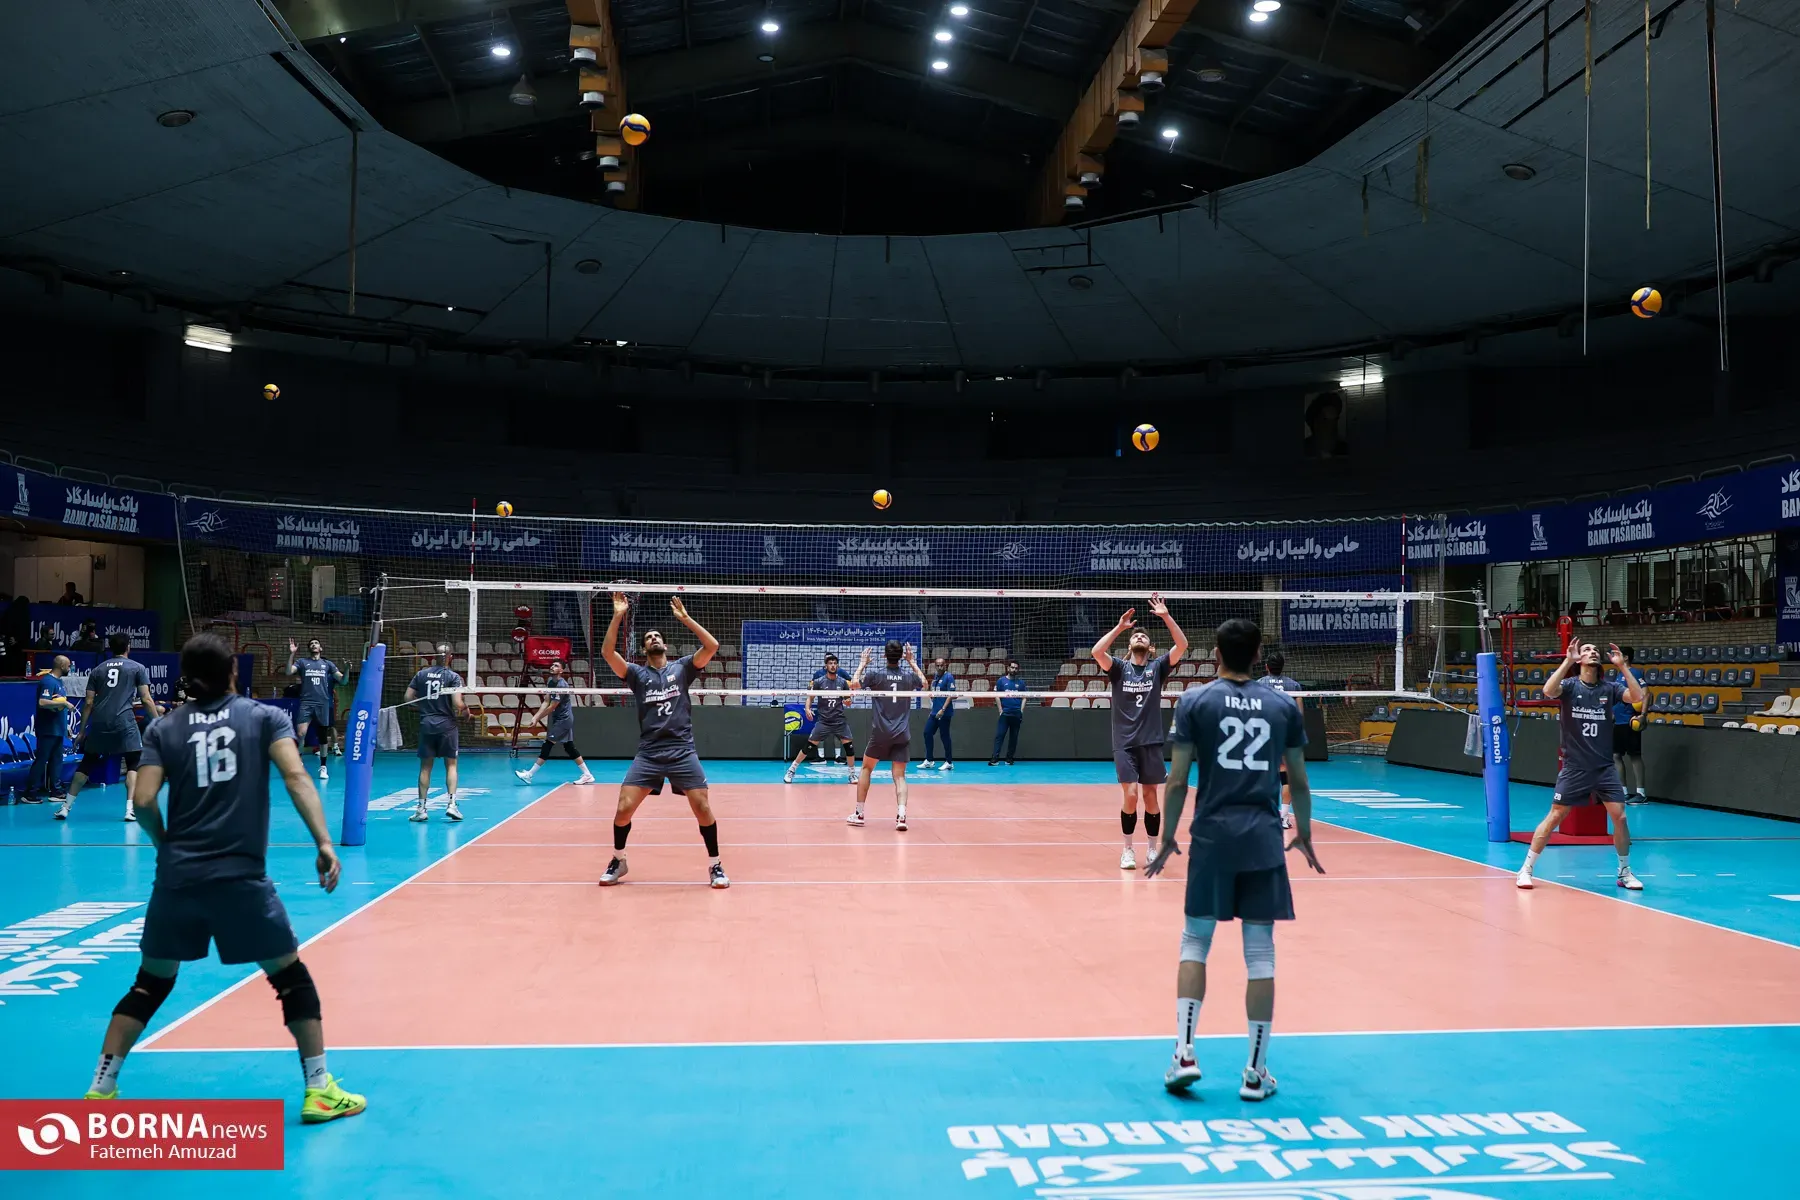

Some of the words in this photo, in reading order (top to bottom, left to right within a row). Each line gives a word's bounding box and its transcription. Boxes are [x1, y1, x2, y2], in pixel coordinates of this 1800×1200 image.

[111, 493, 140, 518] بانک
[1588, 503, 1631, 526] پاسارگاد
[1629, 499, 1652, 521] بانک
[62, 508, 88, 526] BANK
[88, 511, 138, 533] PASARGAD
[331, 517, 360, 539] بانک
[1458, 520, 1486, 541] بانک
[276, 534, 304, 549] BANK
[304, 535, 360, 553] PASARGAD
[411, 528, 449, 550] ایران
[451, 529, 501, 551] والیبال
[502, 530, 541, 552] حامی
[670, 534, 704, 554] بانک
[1588, 529, 1610, 546] BANK
[1610, 523, 1652, 543] PASARGAD
[897, 537, 930, 555] بانک
[1152, 540, 1183, 557] بانک
[1237, 540, 1275, 563] ایران
[1276, 537, 1322, 561] والیبال
[1324, 535, 1360, 560] حامی
[1407, 544, 1433, 559] BANK
[1434, 540, 1486, 557] PASARGAD
[610, 549, 640, 563] BANK
[641, 550, 703, 565] PASARGAD
[837, 554, 869, 567] BANK
[870, 554, 930, 567] PASARGAD
[1090, 557, 1123, 571] BANK
[1124, 557, 1183, 571] PASARGAD
[1289, 614, 1324, 631] BANK
[1325, 612, 1398, 630] PASARGAD
[129, 638, 150, 649] ARGAD
[107, 668, 120, 688] 9
[311, 677, 321, 685] 40
[890, 683, 898, 703] 1
[1135, 694, 1143, 708] 2
[1224, 695, 1262, 711] IRAN
[656, 701, 673, 717] 72
[827, 699, 837, 708] 77
[188, 708, 230, 725] IRAN
[1582, 722, 1598, 738] 20
[352, 721, 366, 761] Senoh
[1217, 716, 1271, 771] 22
[1492, 725, 1501, 764] Senoh
[186, 726, 238, 788] 16
[947, 1116, 1366, 1149] PASARGAD
[1359, 1111, 1588, 1139] BANK
